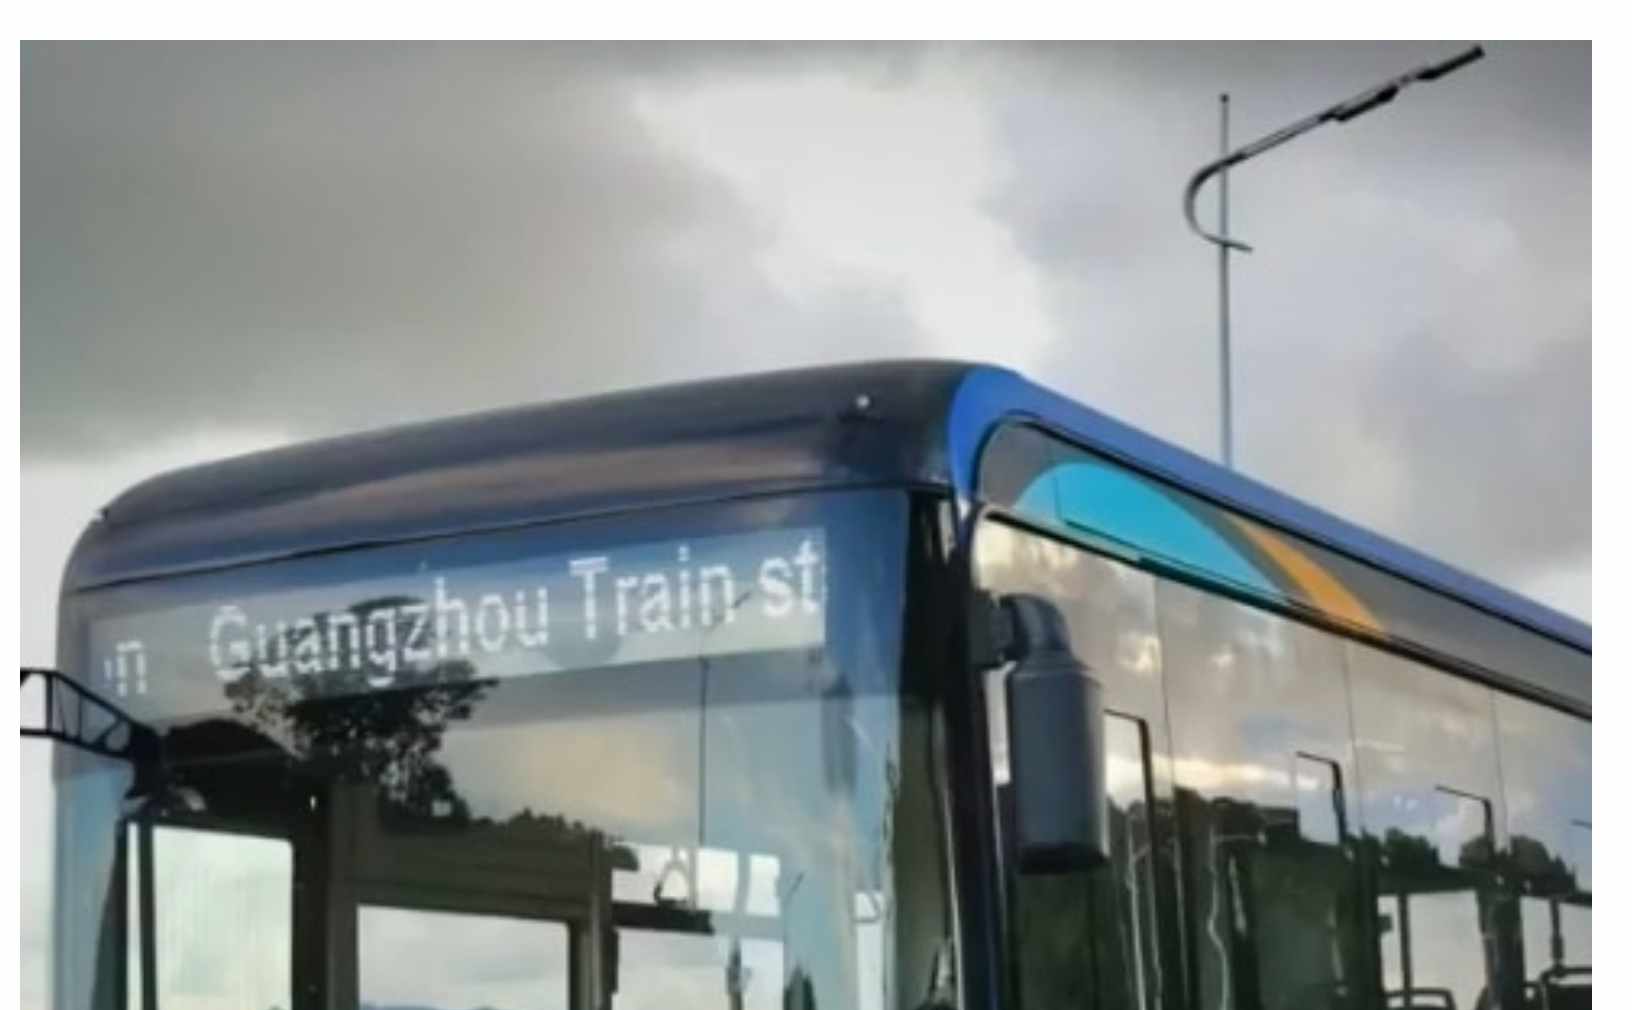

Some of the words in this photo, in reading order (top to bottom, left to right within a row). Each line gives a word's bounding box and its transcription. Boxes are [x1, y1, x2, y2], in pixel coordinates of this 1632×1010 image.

[209, 576, 550, 688] Guangzhou
[568, 544, 736, 640] Train
[759, 540, 821, 618] st
